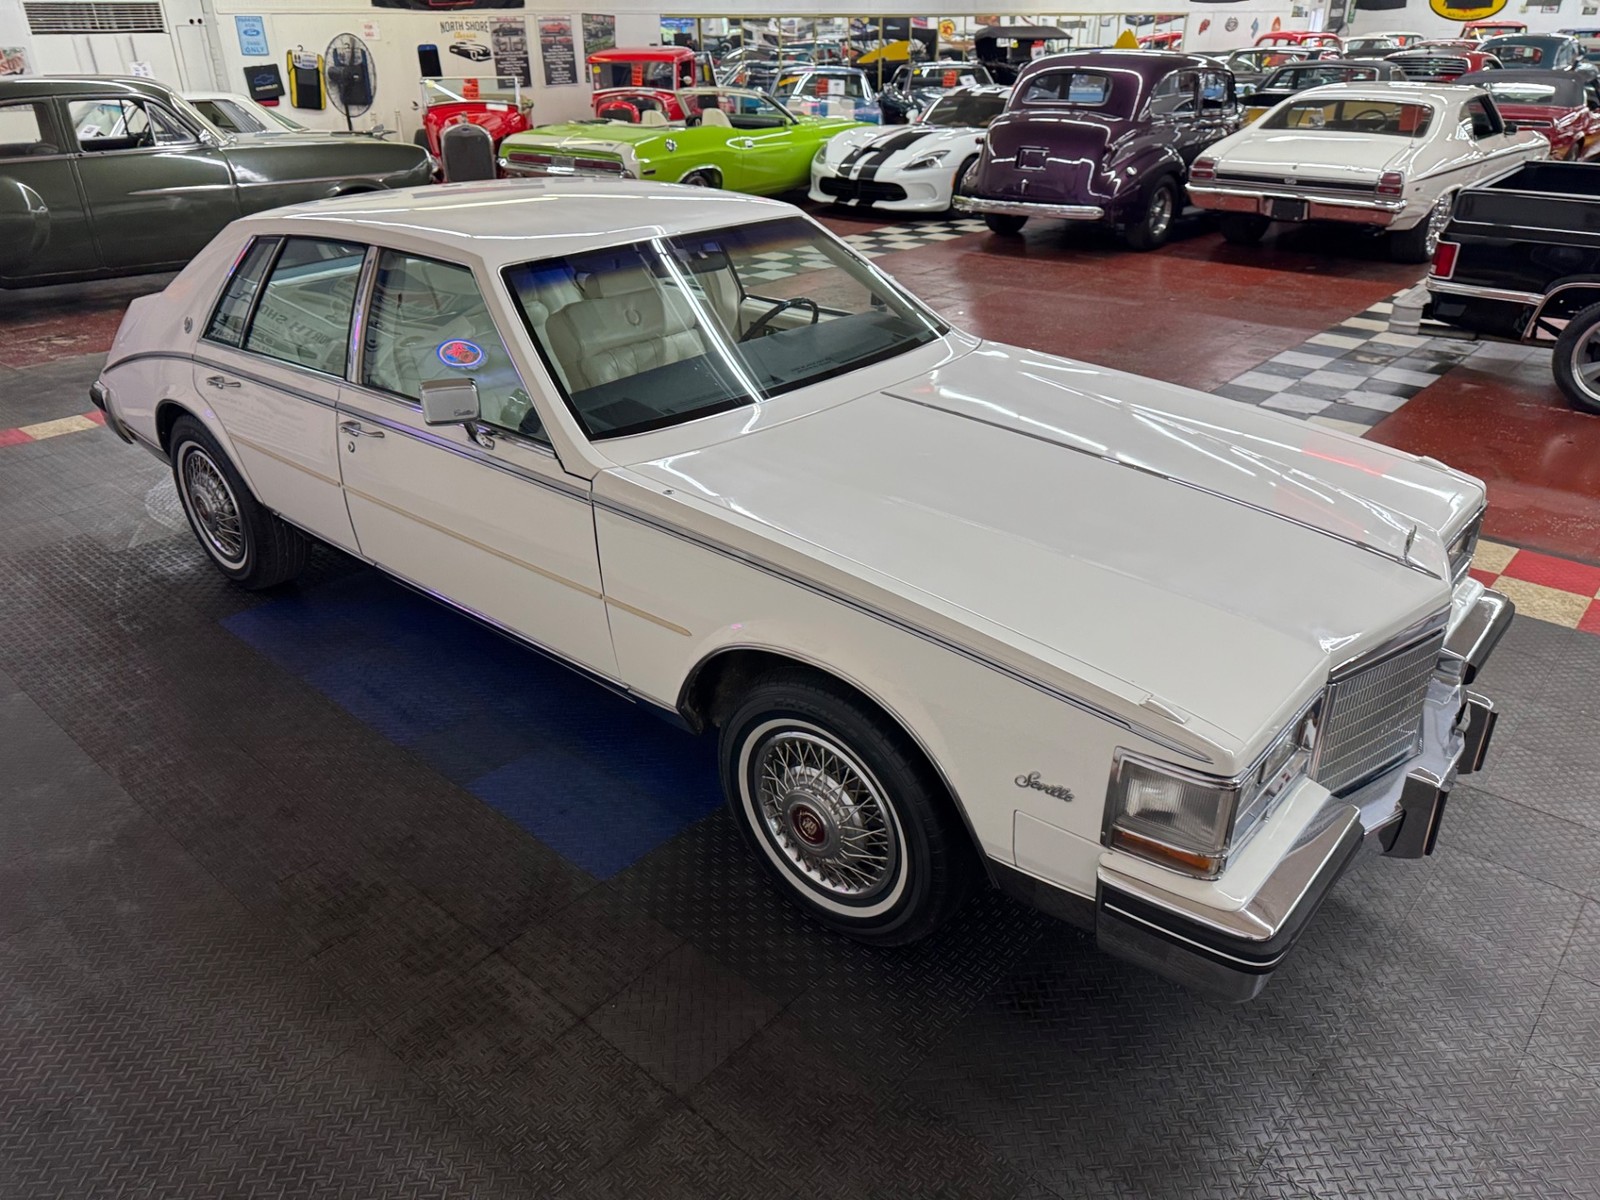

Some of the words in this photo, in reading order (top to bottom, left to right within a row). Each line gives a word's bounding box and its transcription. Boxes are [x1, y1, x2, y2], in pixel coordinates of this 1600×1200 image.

[440, 21, 464, 33] NORTH
[465, 21, 489, 33] SHORE
[1014, 770, 1075, 803] Seville
